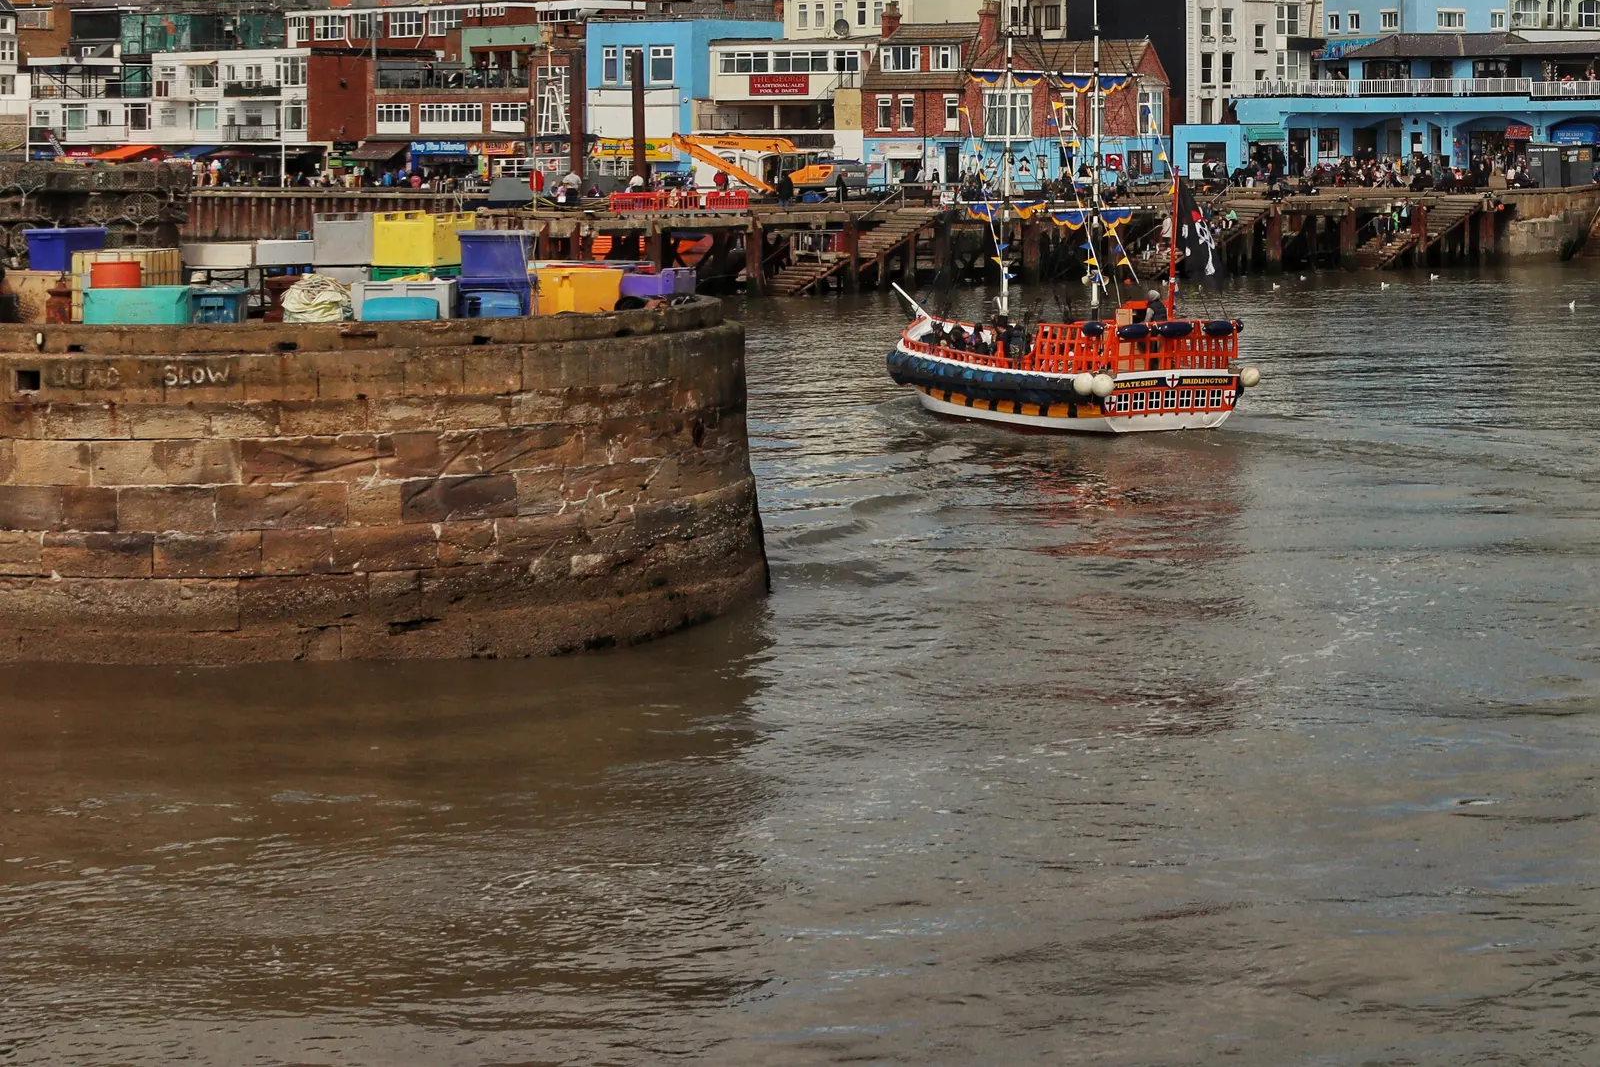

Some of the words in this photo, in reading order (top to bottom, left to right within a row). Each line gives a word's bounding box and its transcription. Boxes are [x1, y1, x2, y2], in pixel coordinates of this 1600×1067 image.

[753, 75, 769, 83] THE
[773, 75, 807, 83] GEORGE
[410, 141, 425, 152] Deep
[163, 363, 230, 386] SLOW
[1114, 381, 1140, 389] PIRATE
[1141, 379, 1158, 387] SHIP
[1182, 377, 1228, 385] BRIDLINGTON
